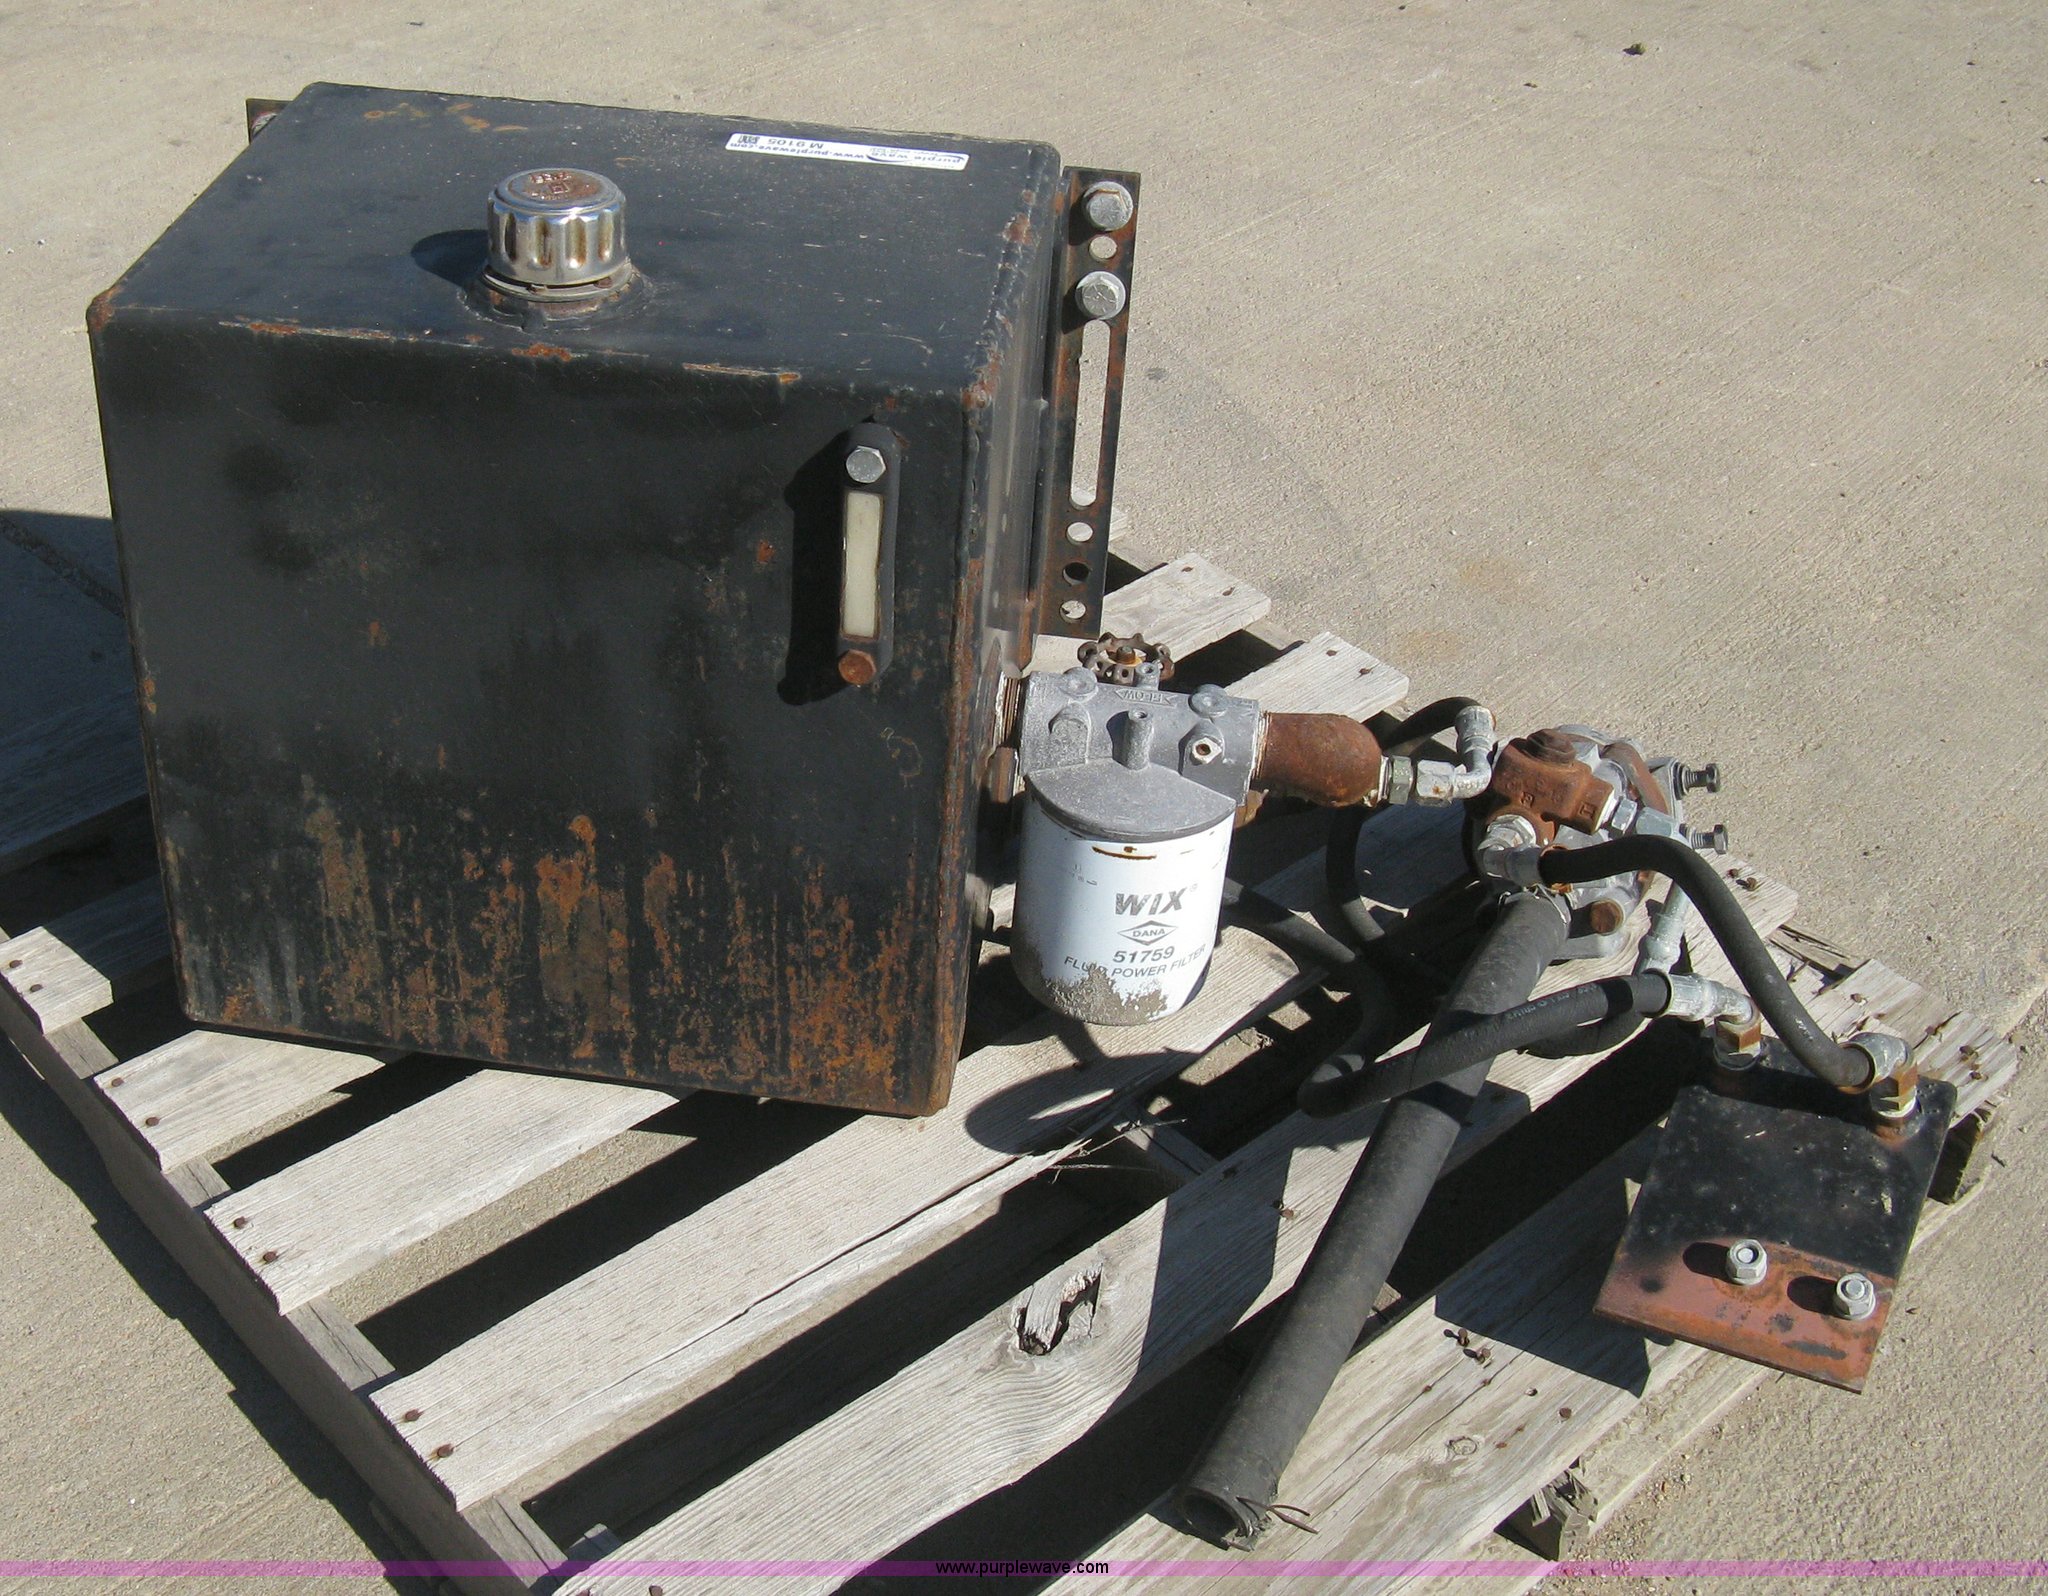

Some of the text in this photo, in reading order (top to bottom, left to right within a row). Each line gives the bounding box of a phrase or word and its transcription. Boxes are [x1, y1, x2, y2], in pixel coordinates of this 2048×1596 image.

[730, 143, 864, 159] www.purplewave.com
[1115, 887, 1188, 916] WIX
[1132, 928, 1167, 938] DANA
[1111, 964, 1167, 978] POWER
[1170, 944, 1206, 970] FILTER
[1112, 946, 1175, 964] 51759
